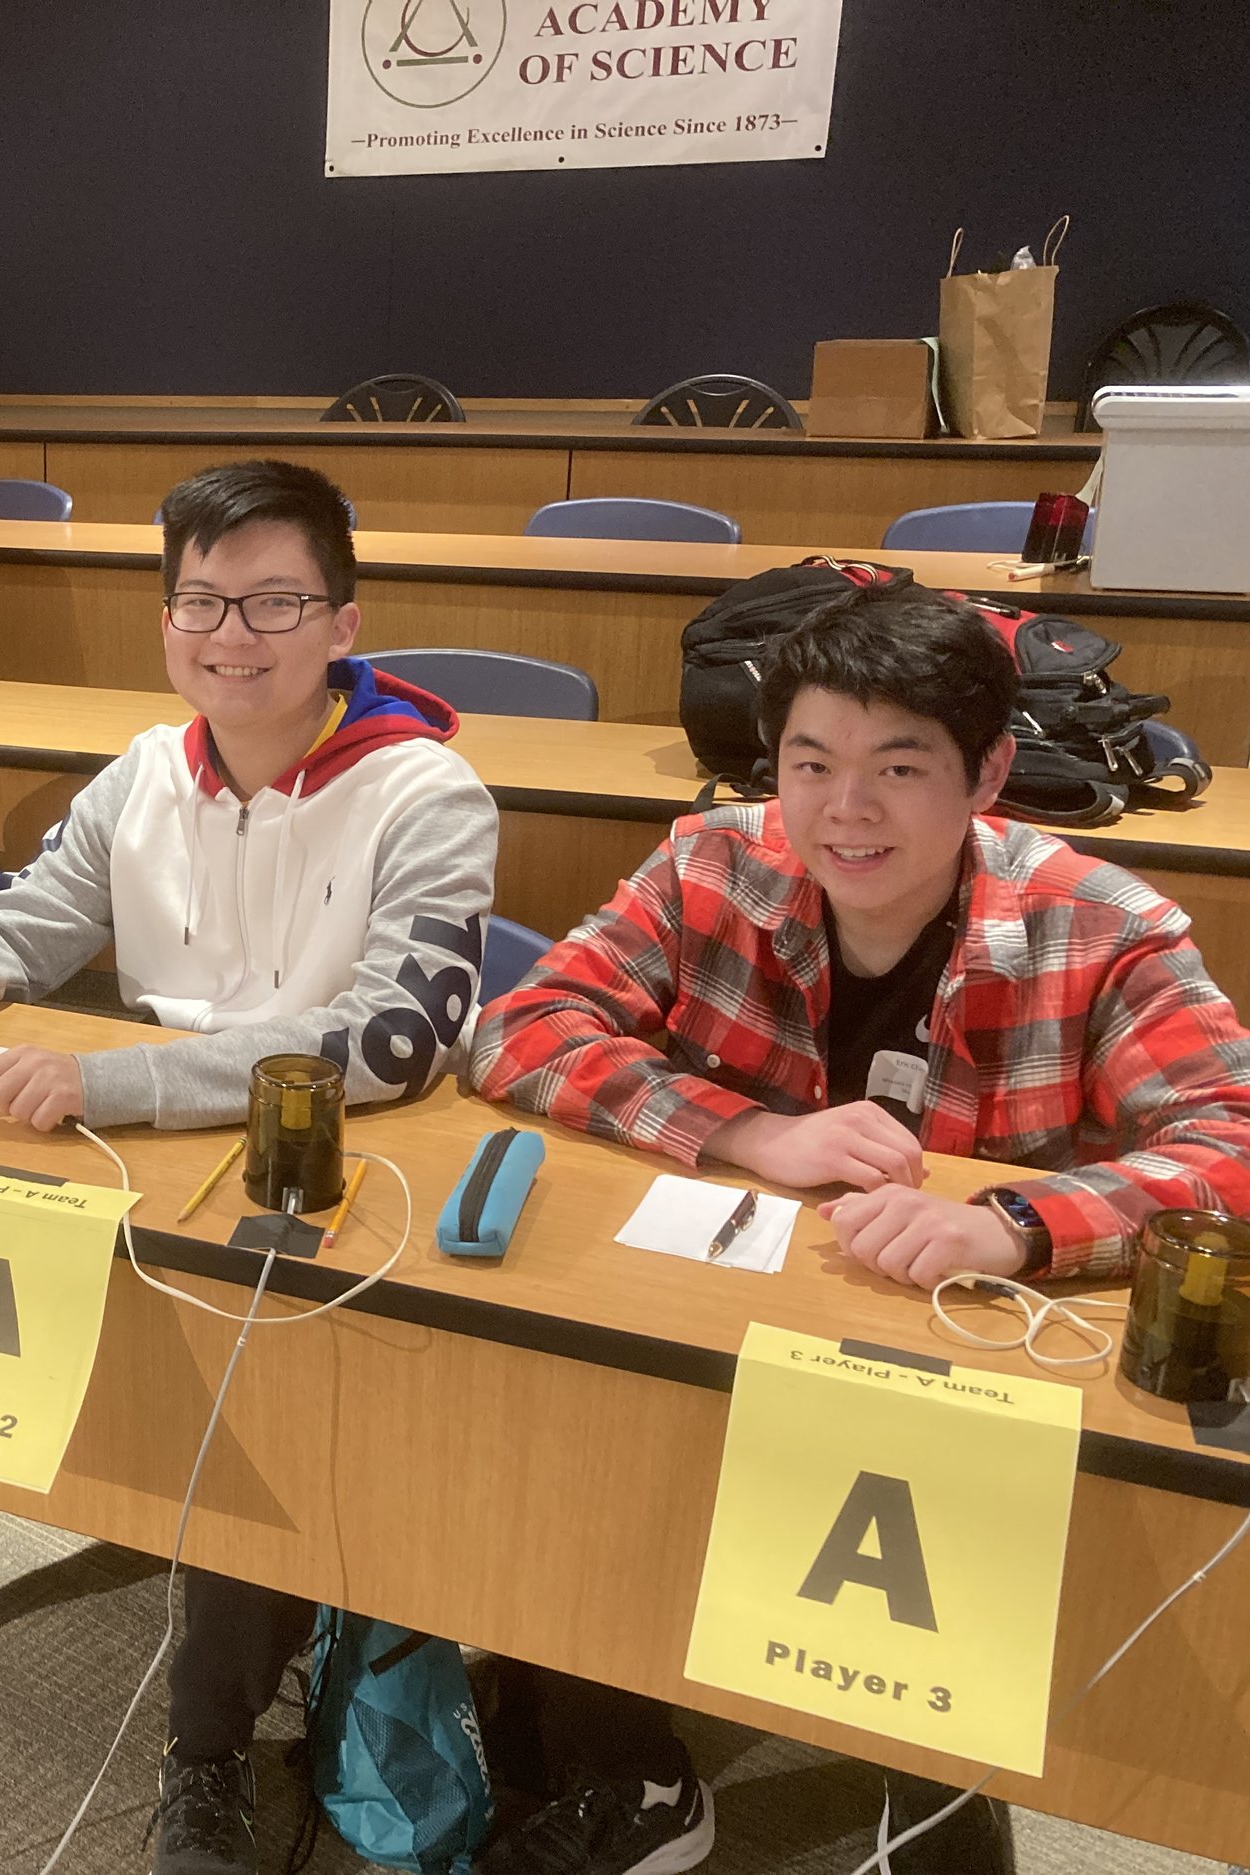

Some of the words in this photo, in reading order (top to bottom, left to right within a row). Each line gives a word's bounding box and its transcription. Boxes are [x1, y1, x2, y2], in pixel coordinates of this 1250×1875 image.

[534, 0, 771, 38] ACADEMY
[518, 53, 579, 85] OF
[590, 37, 798, 82] SCIENCE
[467, 127, 564, 144] Excellence
[570, 124, 588, 140] in
[594, 122, 667, 139] Science
[673, 118, 727, 135] Since
[25, 1190, 40, 1198] A
[42, 1192, 88, 1209] Team
[789, 1350, 804, 1361] 3
[810, 1353, 891, 1380] Player
[916, 1375, 935, 1388] A
[943, 1380, 1015, 1405] Team
[795, 1470, 939, 1634] A
[764, 1640, 909, 1702] Player
[926, 1685, 954, 1714] 3
